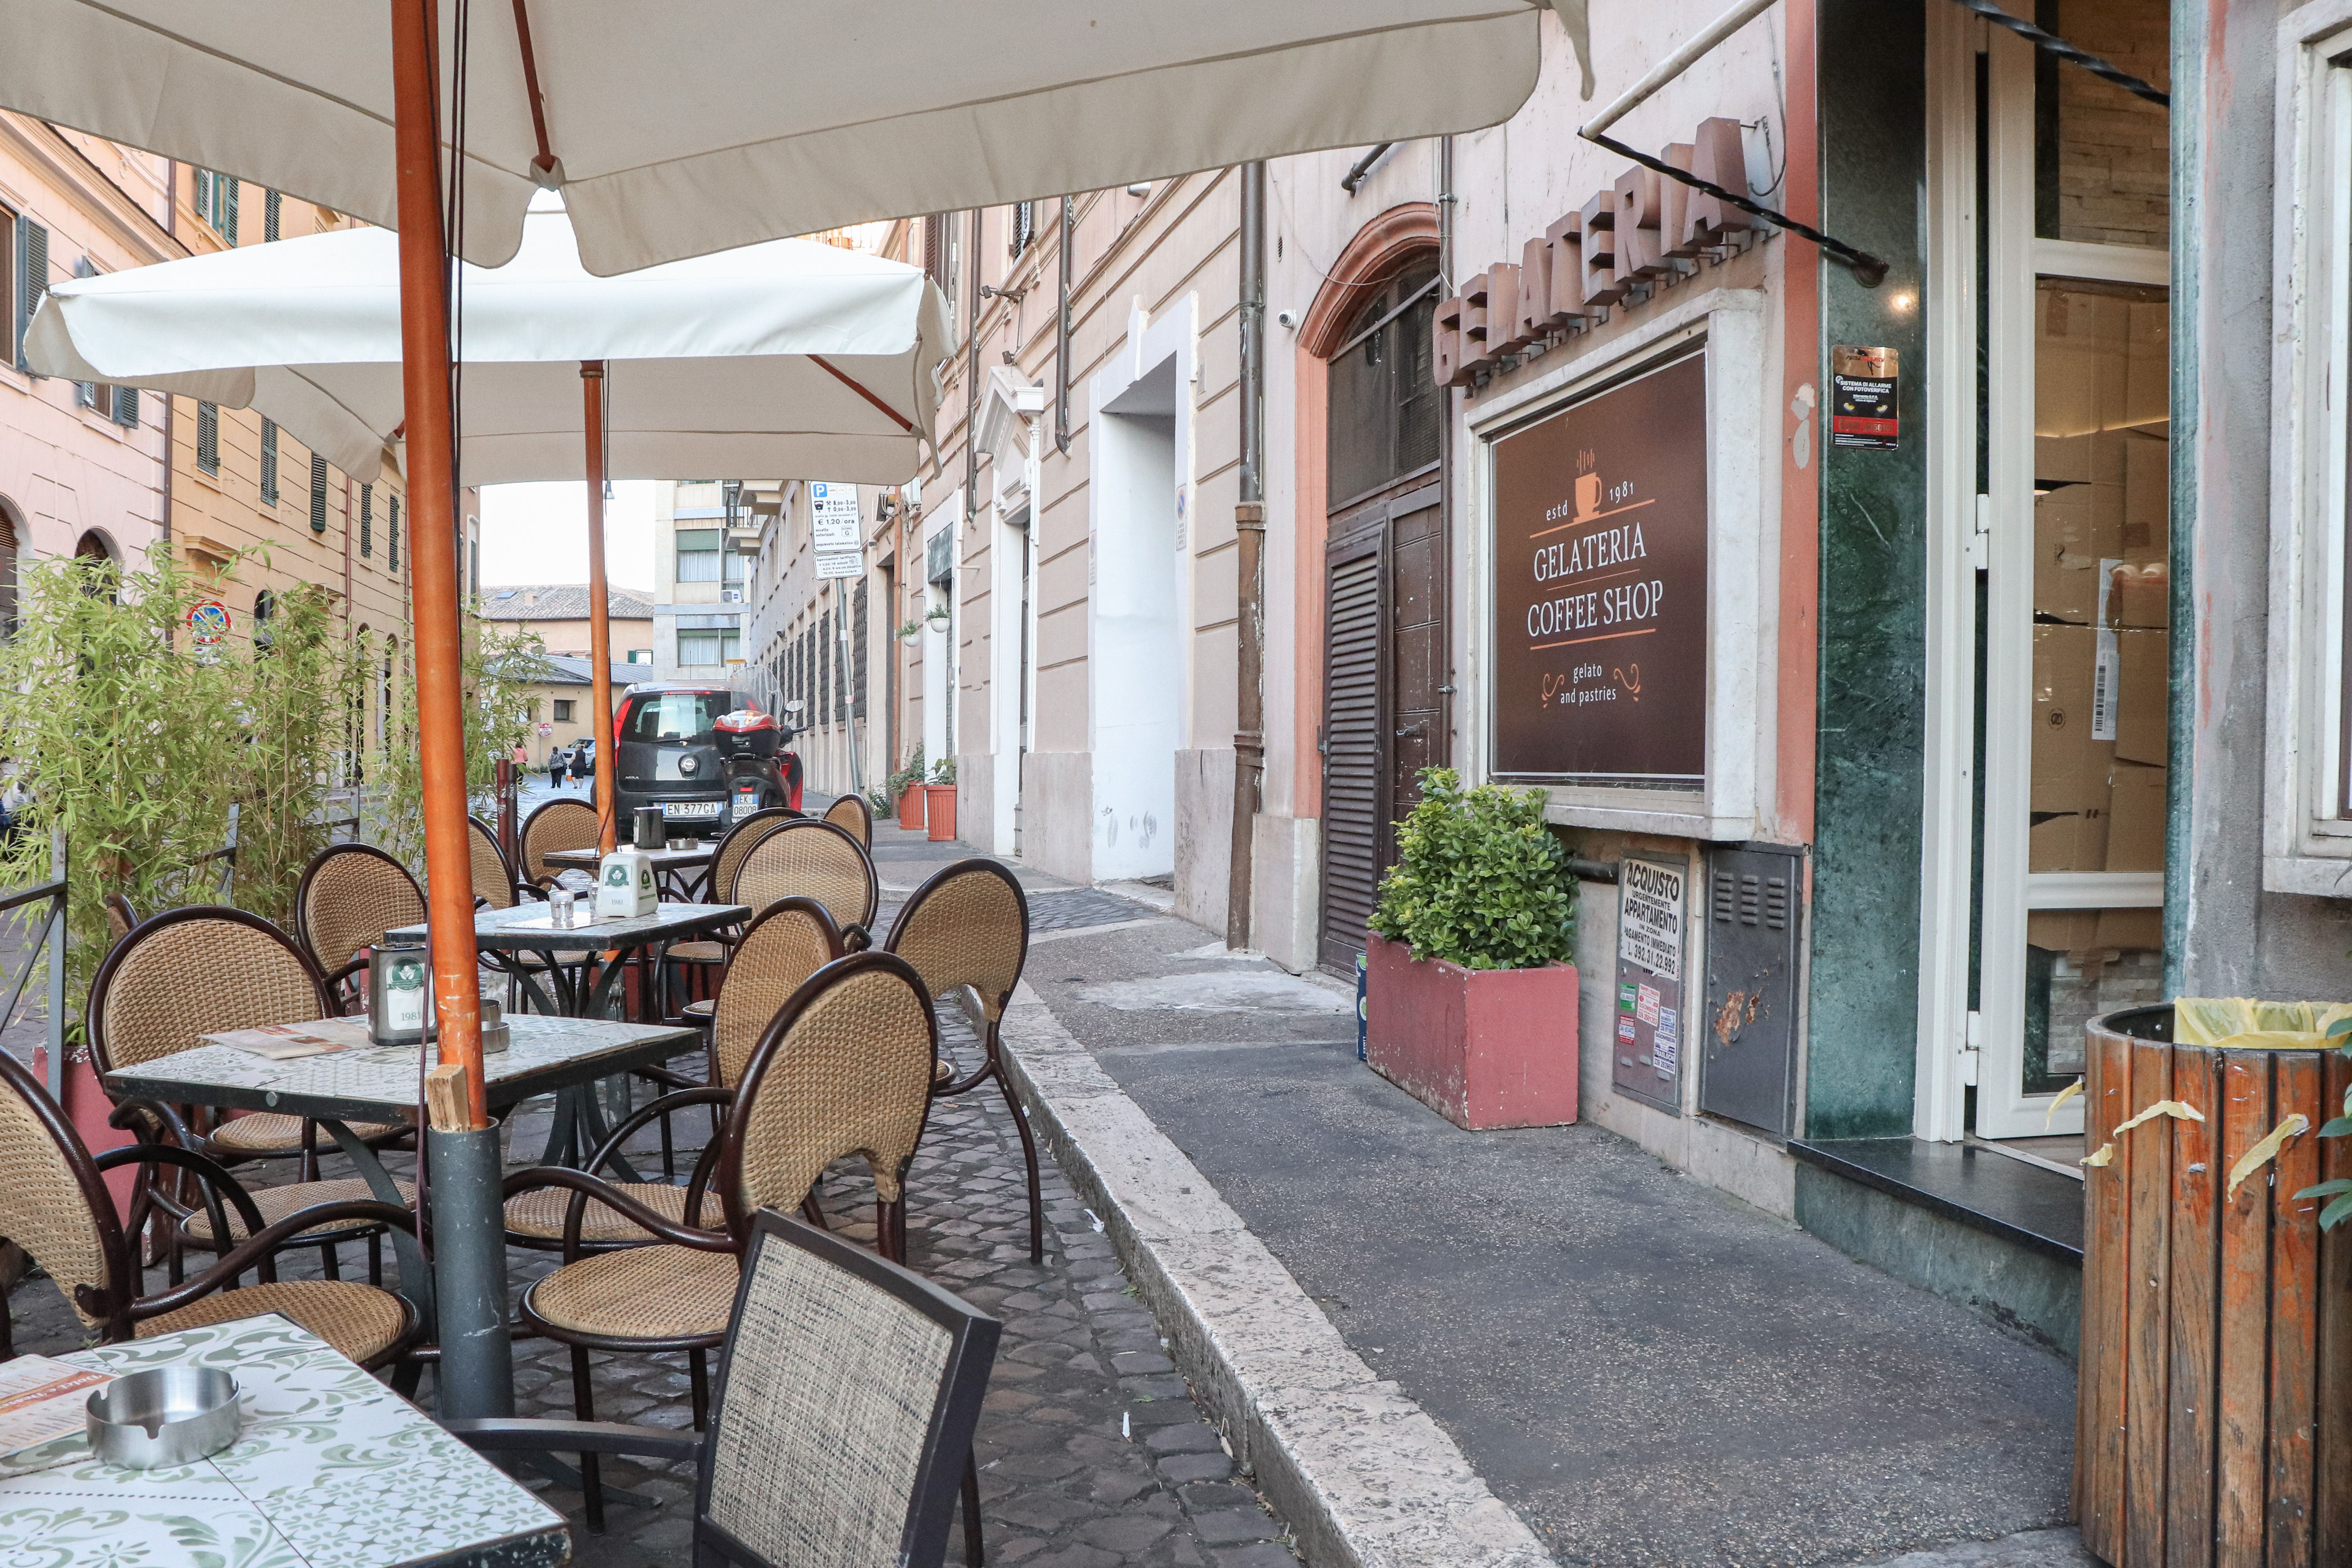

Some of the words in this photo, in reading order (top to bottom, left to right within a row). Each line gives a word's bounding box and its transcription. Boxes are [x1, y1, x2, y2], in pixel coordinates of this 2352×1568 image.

[1433, 117, 1751, 387] GELATERIA
[1609, 481, 1634, 504] 1981
[1546, 500, 1568, 521] estd
[1534, 522, 1647, 582] GELATERIA
[1527, 591, 1598, 638] COFFEE
[1603, 580, 1663, 625] SHOP
[1573, 663, 1602, 683] gelato
[1560, 688, 1576, 704] and
[1579, 686, 1617, 707] pastries
[740, 795, 748, 803] EK
[734, 805, 757, 815] 08008
[1627, 862, 1679, 902] ACQUISTO
[1632, 890, 1671, 911] URGENTEMENTE
[1624, 897, 1677, 935] APPARTAMENTO
[1646, 926, 1661, 937] ZONA
[1651, 937, 1676, 957] IMMEDIATO
[1634, 944, 1675, 975] 392.31.22.992
[401, 1012, 421, 1021] 1981
